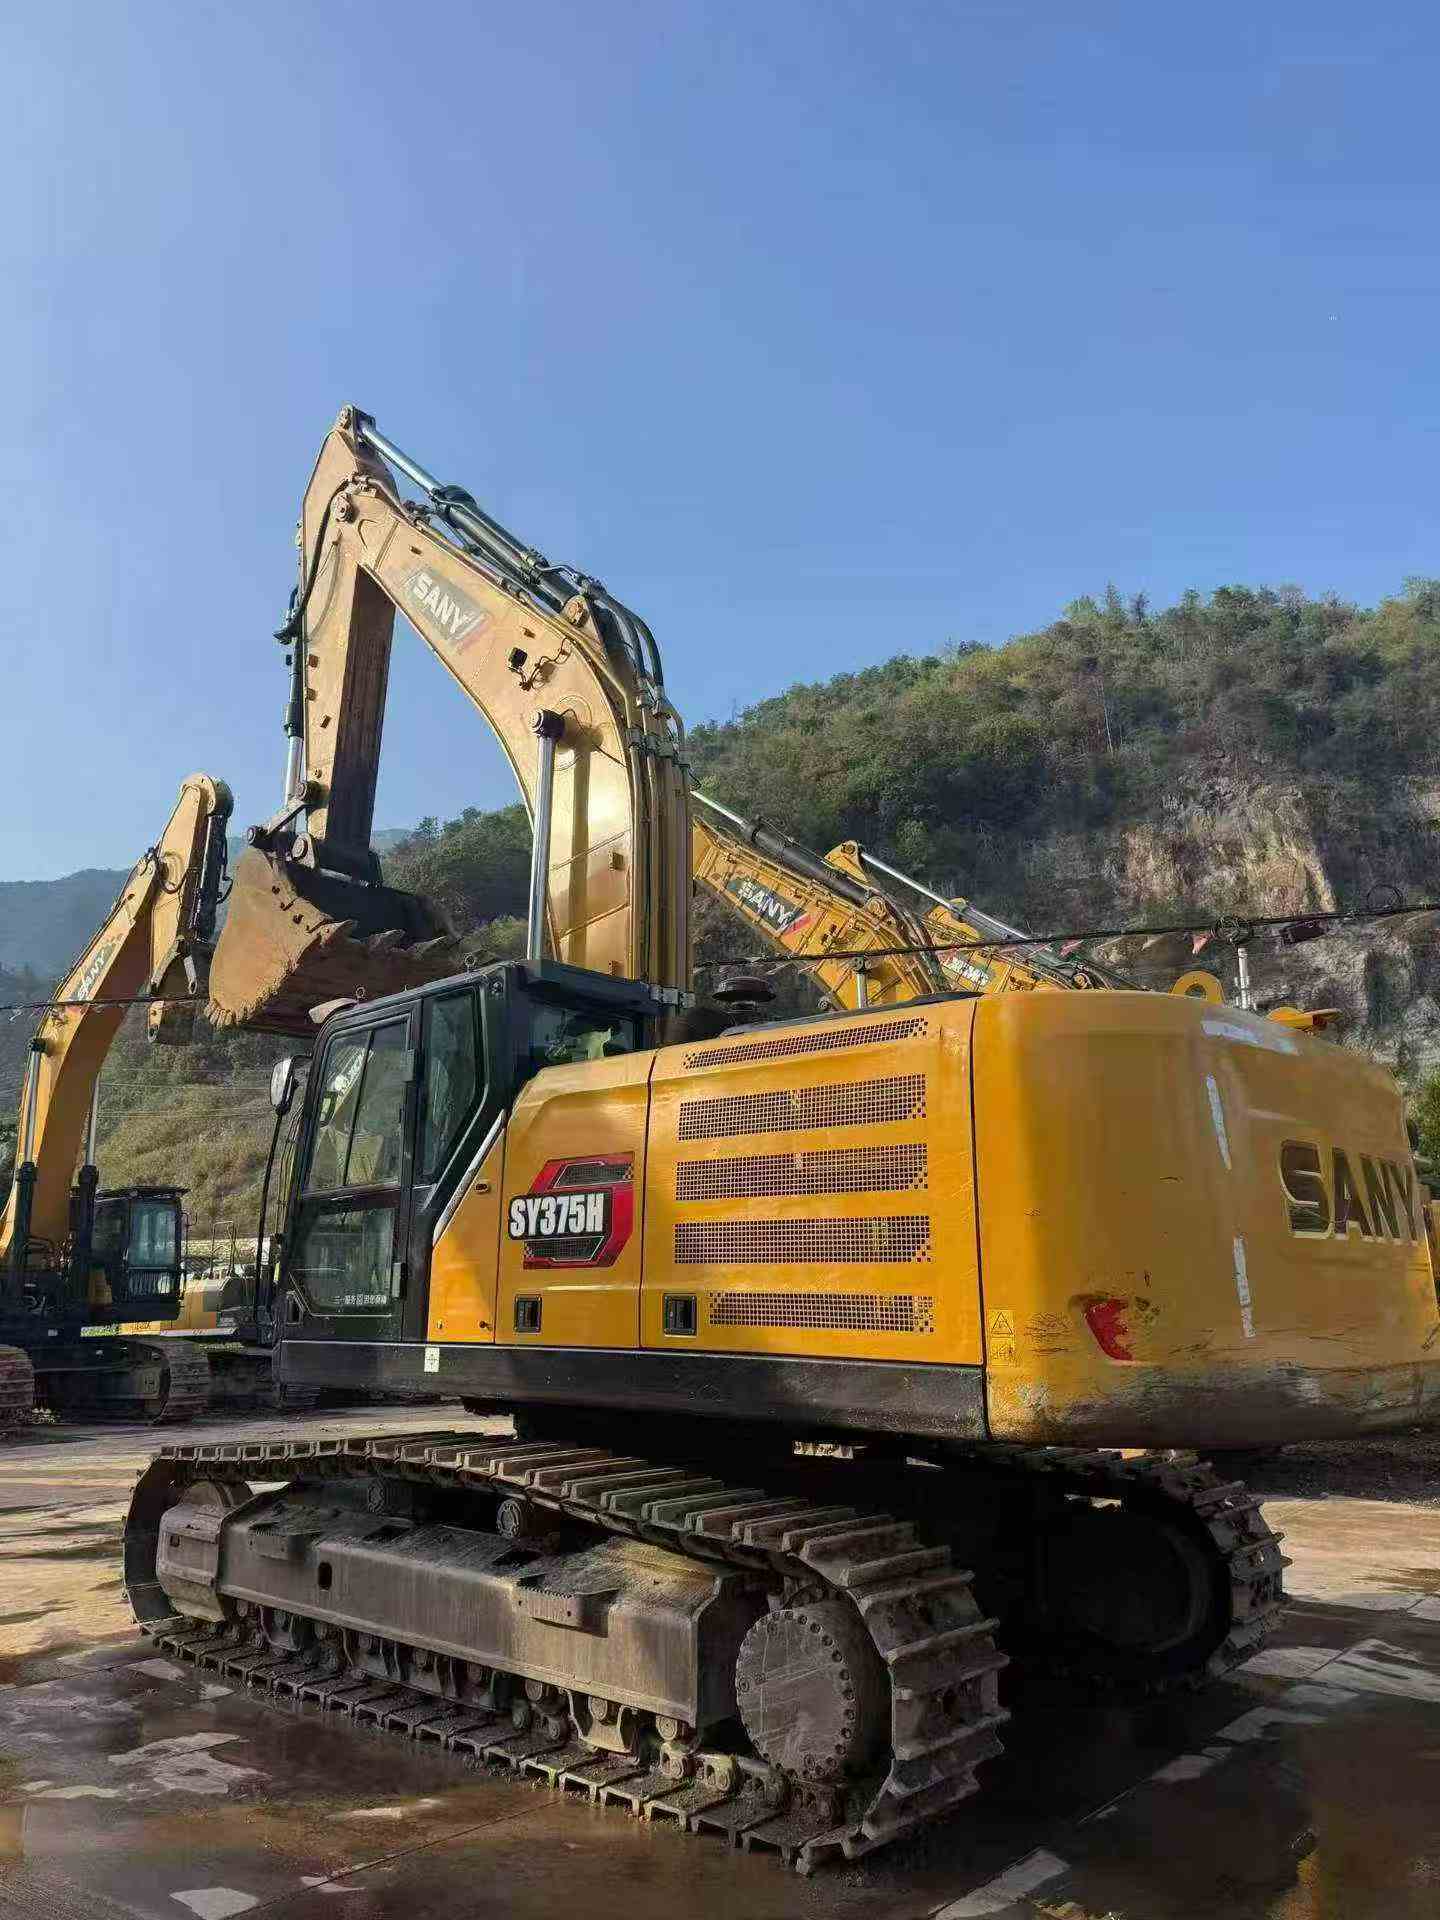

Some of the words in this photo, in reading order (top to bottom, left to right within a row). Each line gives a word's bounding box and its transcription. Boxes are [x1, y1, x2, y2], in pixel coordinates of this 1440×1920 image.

[412, 573, 477, 634] SANY
[738, 881, 798, 926] SANY
[510, 1193, 604, 1236] SY375H
